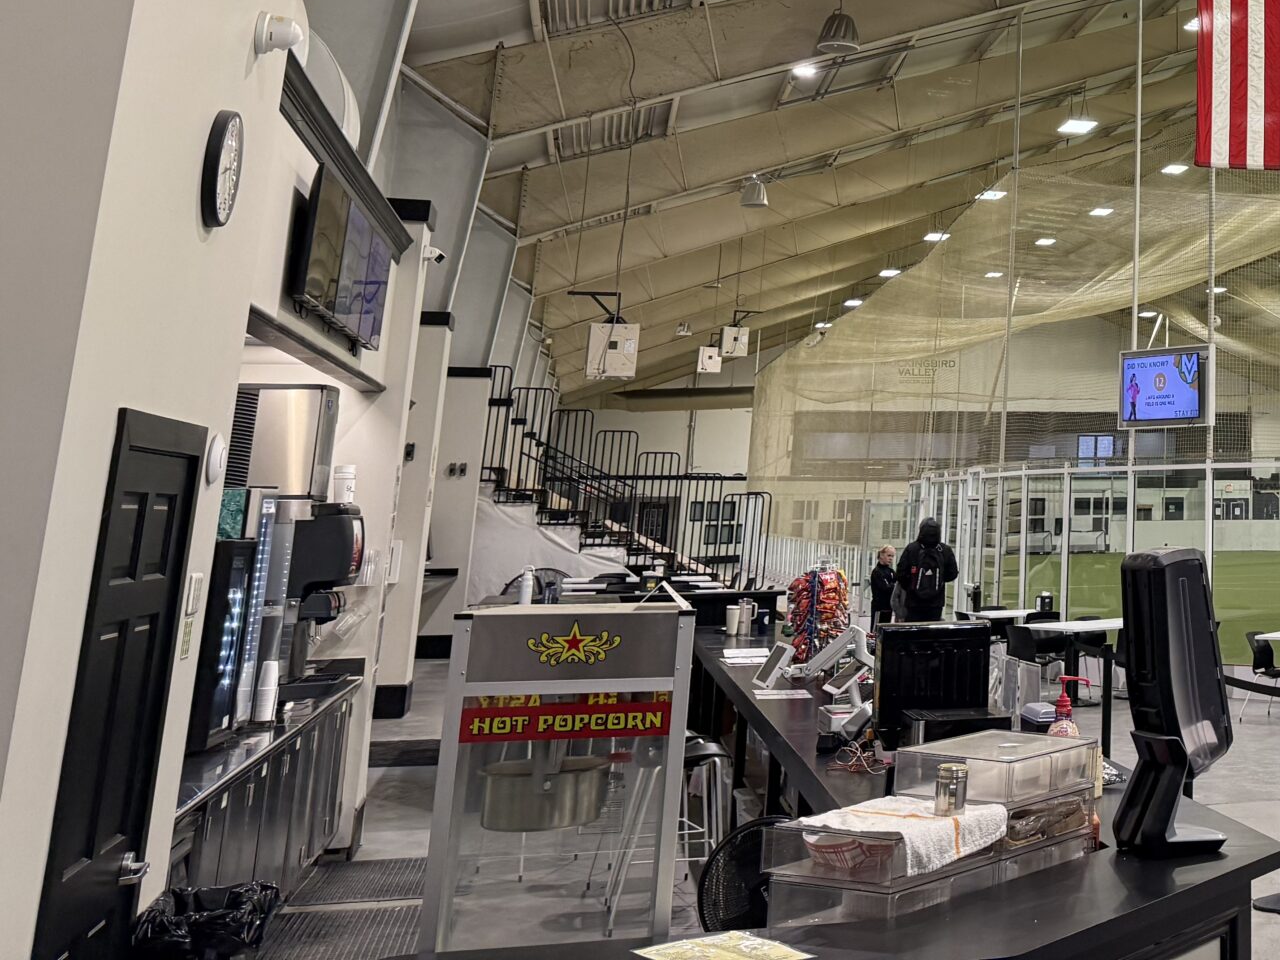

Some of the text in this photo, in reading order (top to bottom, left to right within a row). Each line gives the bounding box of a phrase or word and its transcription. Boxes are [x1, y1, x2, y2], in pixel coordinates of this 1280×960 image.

[1127, 362, 1136, 370] DID
[1148, 360, 1169, 368] KNOW?
[898, 368, 937, 377] VALLEY
[1155, 377, 1164, 387] 12
[469, 711, 663, 735] HOT POPCORN
